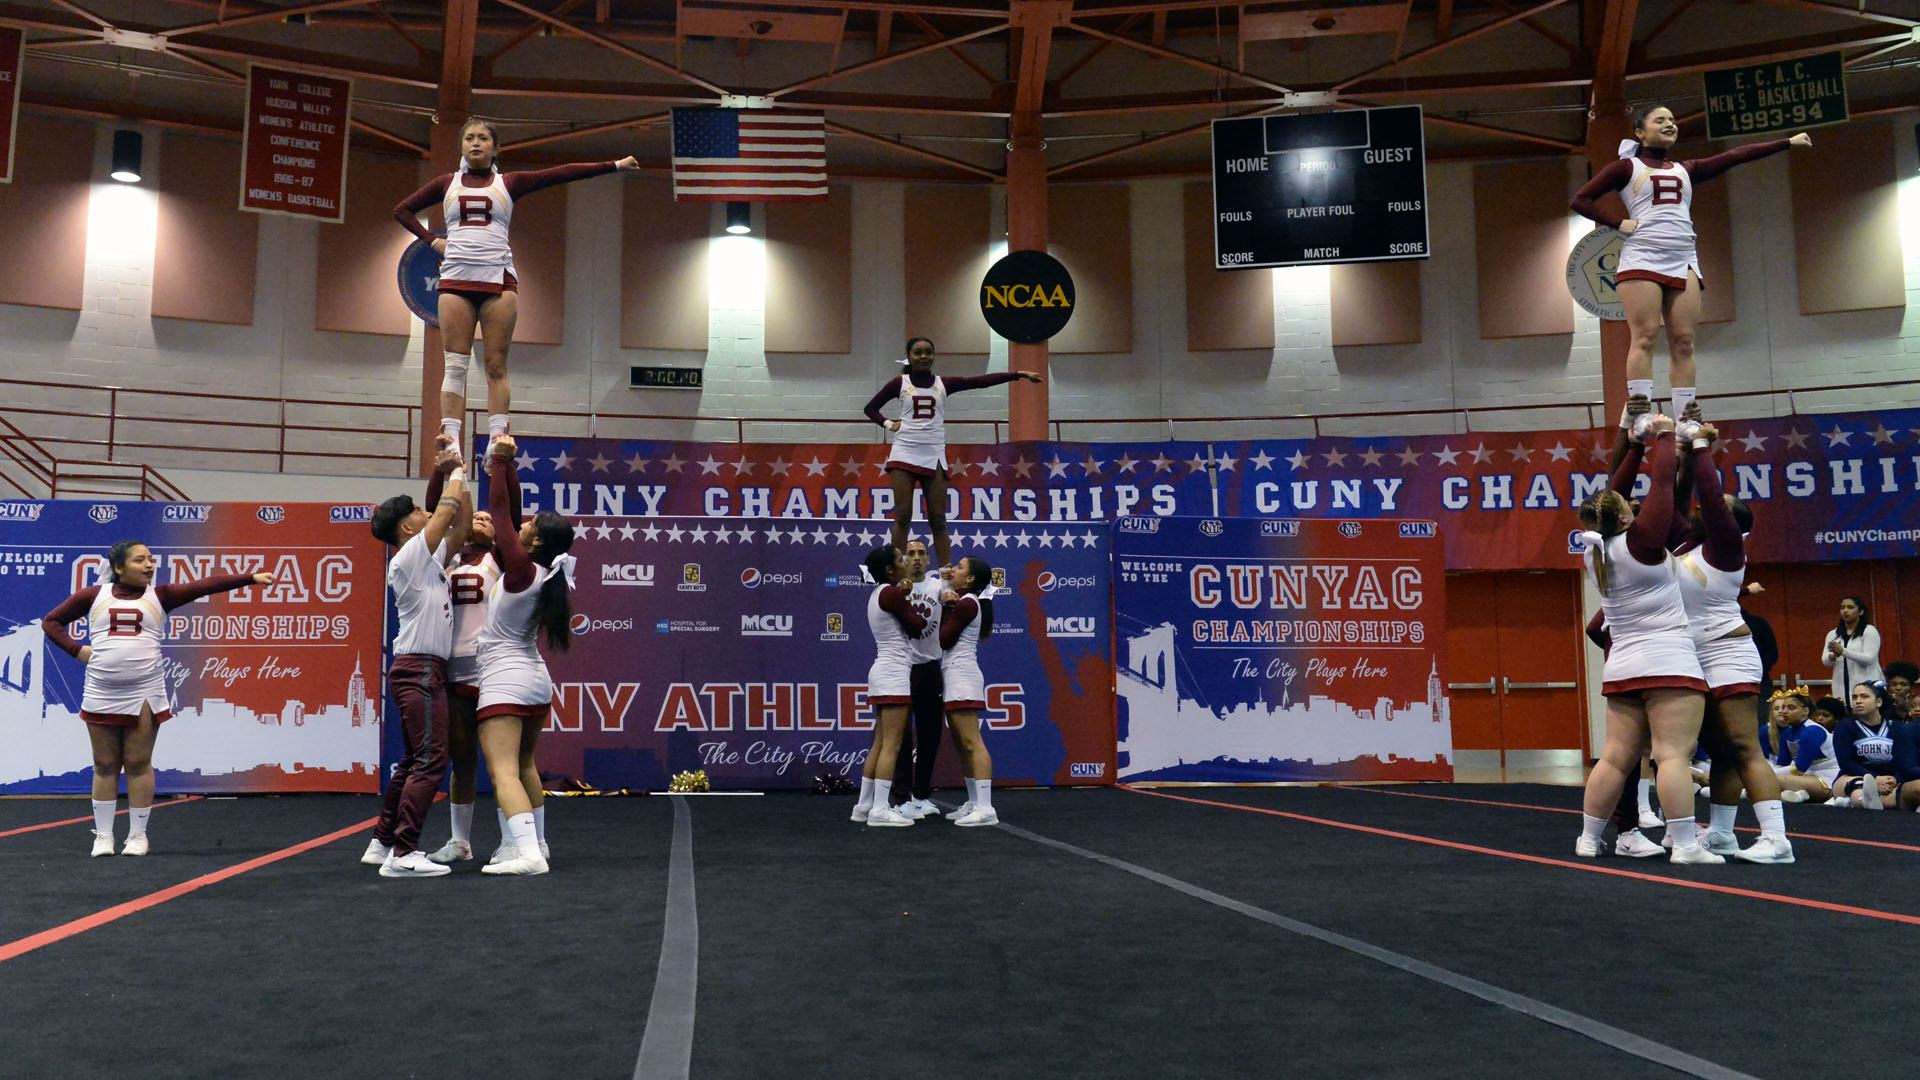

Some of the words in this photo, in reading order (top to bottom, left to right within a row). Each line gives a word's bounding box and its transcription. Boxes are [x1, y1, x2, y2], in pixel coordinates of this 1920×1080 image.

[298, 83, 333, 98] COLLEGE
[1709, 93, 1747, 113] MEN'S
[1758, 77, 1842, 108] BASKETBALL
[266, 97, 297, 110] HUDSON
[303, 102, 331, 115] VALLEY
[259, 115, 293, 129] WOMEN'S
[299, 120, 336, 135] ATHLETIC
[1730, 102, 1824, 132] 1993-94
[271, 135, 321, 151] CONFERENCE
[273, 154, 316, 169] CHAMPIONS
[1364, 147, 1413, 164] GUEST
[1226, 157, 1269, 173] HOME
[1299, 161, 1336, 172] PERIOD
[249, 188, 282, 201] WOMEN'S
[288, 193, 336, 209] BASKETBALL
[1650, 175, 1683, 206] B
[458, 196, 493, 227] B
[1287, 206, 1326, 218] PLAYER
[1329, 204, 1355, 216] FOUL
[1388, 200, 1421, 212] FOULS
[1220, 211, 1253, 223] FOULS
[1304, 247, 1340, 258] MATCH
[1390, 242, 1423, 254] SCORE
[1222, 252, 1254, 264] SCORE
[984, 284, 1071, 308] NCAA
[912, 395, 936, 419] B
[521, 483, 667, 516] CUNY
[1255, 478, 1402, 513] CUNY
[163, 505, 210, 521] CUNY
[330, 505, 376, 522] CUNY
[1120, 517, 1161, 532] CUNY
[1261, 521, 1300, 535] CUNY
[1399, 522, 1437, 537] CUNY
[0, 553, 64, 563] ELCOME
[16, 565, 46, 576] THE
[601, 564, 655, 581] MCU
[1121, 561, 1182, 572] WELCOME
[763, 571, 803, 586] pepsi
[1058, 575, 1096, 588] pepsi
[1122, 573, 1138, 582] TO
[1144, 573, 1168, 583] THE
[450, 573, 484, 605] B
[1190, 564, 1423, 610] CUNYAC
[108, 608, 144, 637] B
[592, 618, 633, 632] pepsi
[741, 615, 793, 631] MCU
[1046, 617, 1095, 633] MCU
[1193, 620, 1425, 643] CHAMPIONSHIPS
[200, 657, 252, 687] Plays
[257, 655, 302, 679] Here
[1232, 658, 1259, 679] The
[1266, 658, 1297, 685] City
[1305, 658, 1347, 685] Plays
[1352, 657, 1388, 679] Here
[1858, 743, 1882, 755] JOHN
[698, 741, 740, 766] The
[744, 741, 796, 775] City
[800, 741, 870, 776] Plays
[1071, 763, 1105, 775] CUNY
